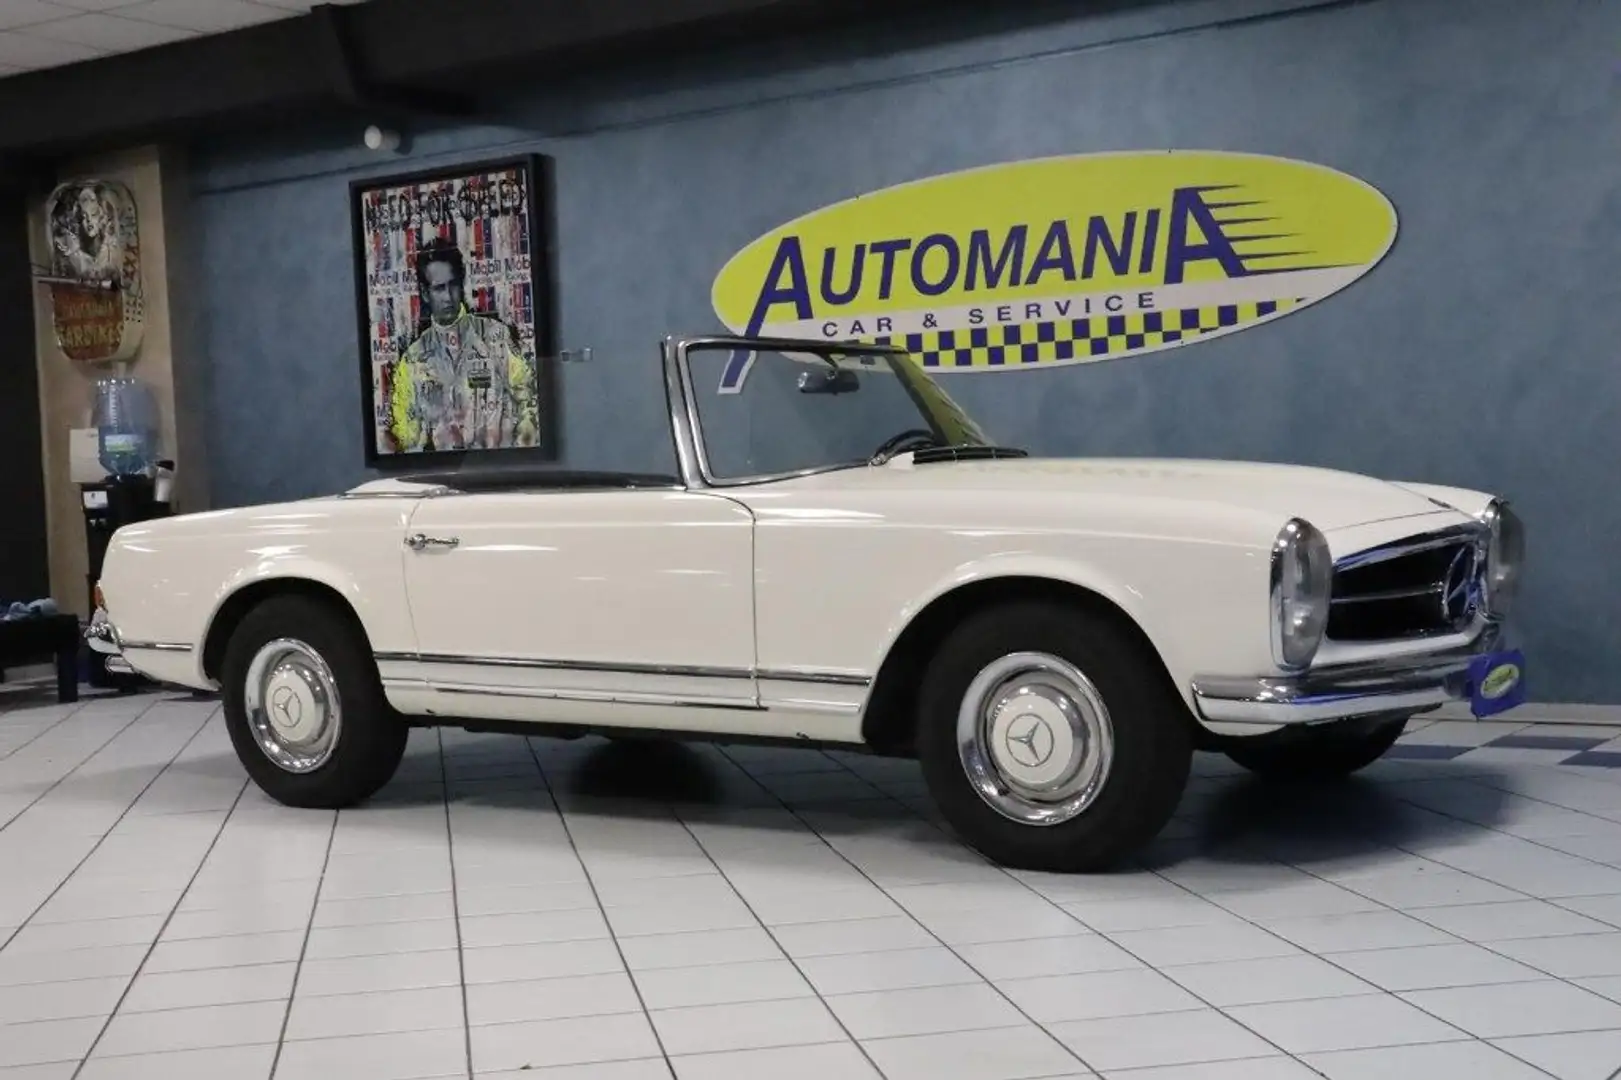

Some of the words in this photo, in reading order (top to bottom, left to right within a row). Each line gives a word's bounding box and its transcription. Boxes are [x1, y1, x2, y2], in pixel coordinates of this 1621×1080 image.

[722, 187, 1249, 388] AUTOMANIA
[822, 317, 893, 338] CAR
[922, 313, 939, 329] &
[968, 291, 1156, 325] SERVICE
